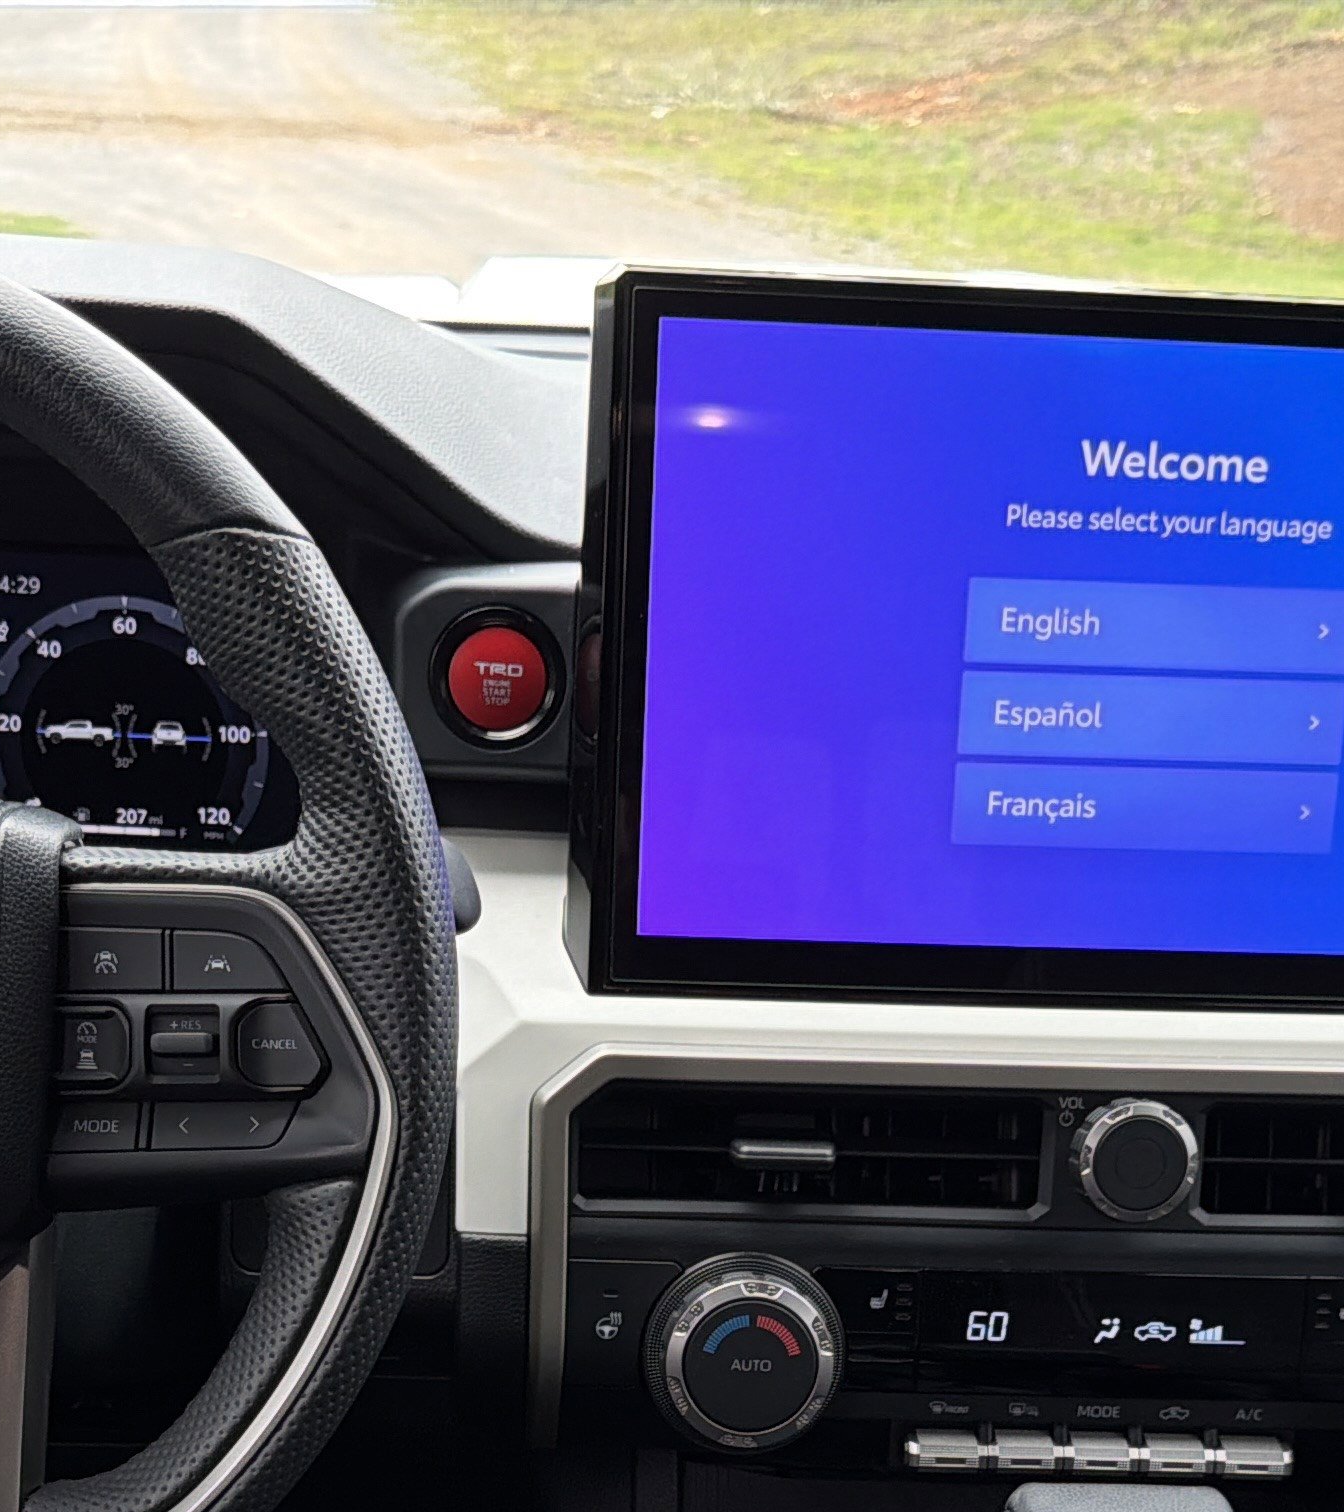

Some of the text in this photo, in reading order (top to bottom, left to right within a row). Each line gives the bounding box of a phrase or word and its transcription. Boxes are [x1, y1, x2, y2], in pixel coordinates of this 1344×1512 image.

[1080, 438, 1269, 483] Welcome
[1005, 502, 1333, 544] Please select your language
[112, 616, 137, 635] 60
[1000, 606, 1101, 642] English
[37, 640, 62, 659] 40
[472, 660, 524, 678] TRD
[482, 688, 512, 698] START
[484, 697, 511, 706] STOP
[992, 699, 1103, 732] Español
[219, 725, 251, 744] 100
[197, 807, 231, 825] 120
[985, 790, 1097, 825] Français
[115, 808, 164, 825] 207 mi
[179, 828, 188, 839] F
[76, 1034, 98, 1044] MODE
[251, 1038, 298, 1051] CANCEL
[1058, 1096, 1086, 1110] VOL
[72, 1119, 120, 1133] MODE
[966, 1310, 1009, 1342] 60
[730, 1358, 772, 1372] AUTO
[1076, 1404, 1121, 1419] MODE
[1235, 1408, 1263, 1421] A/C
